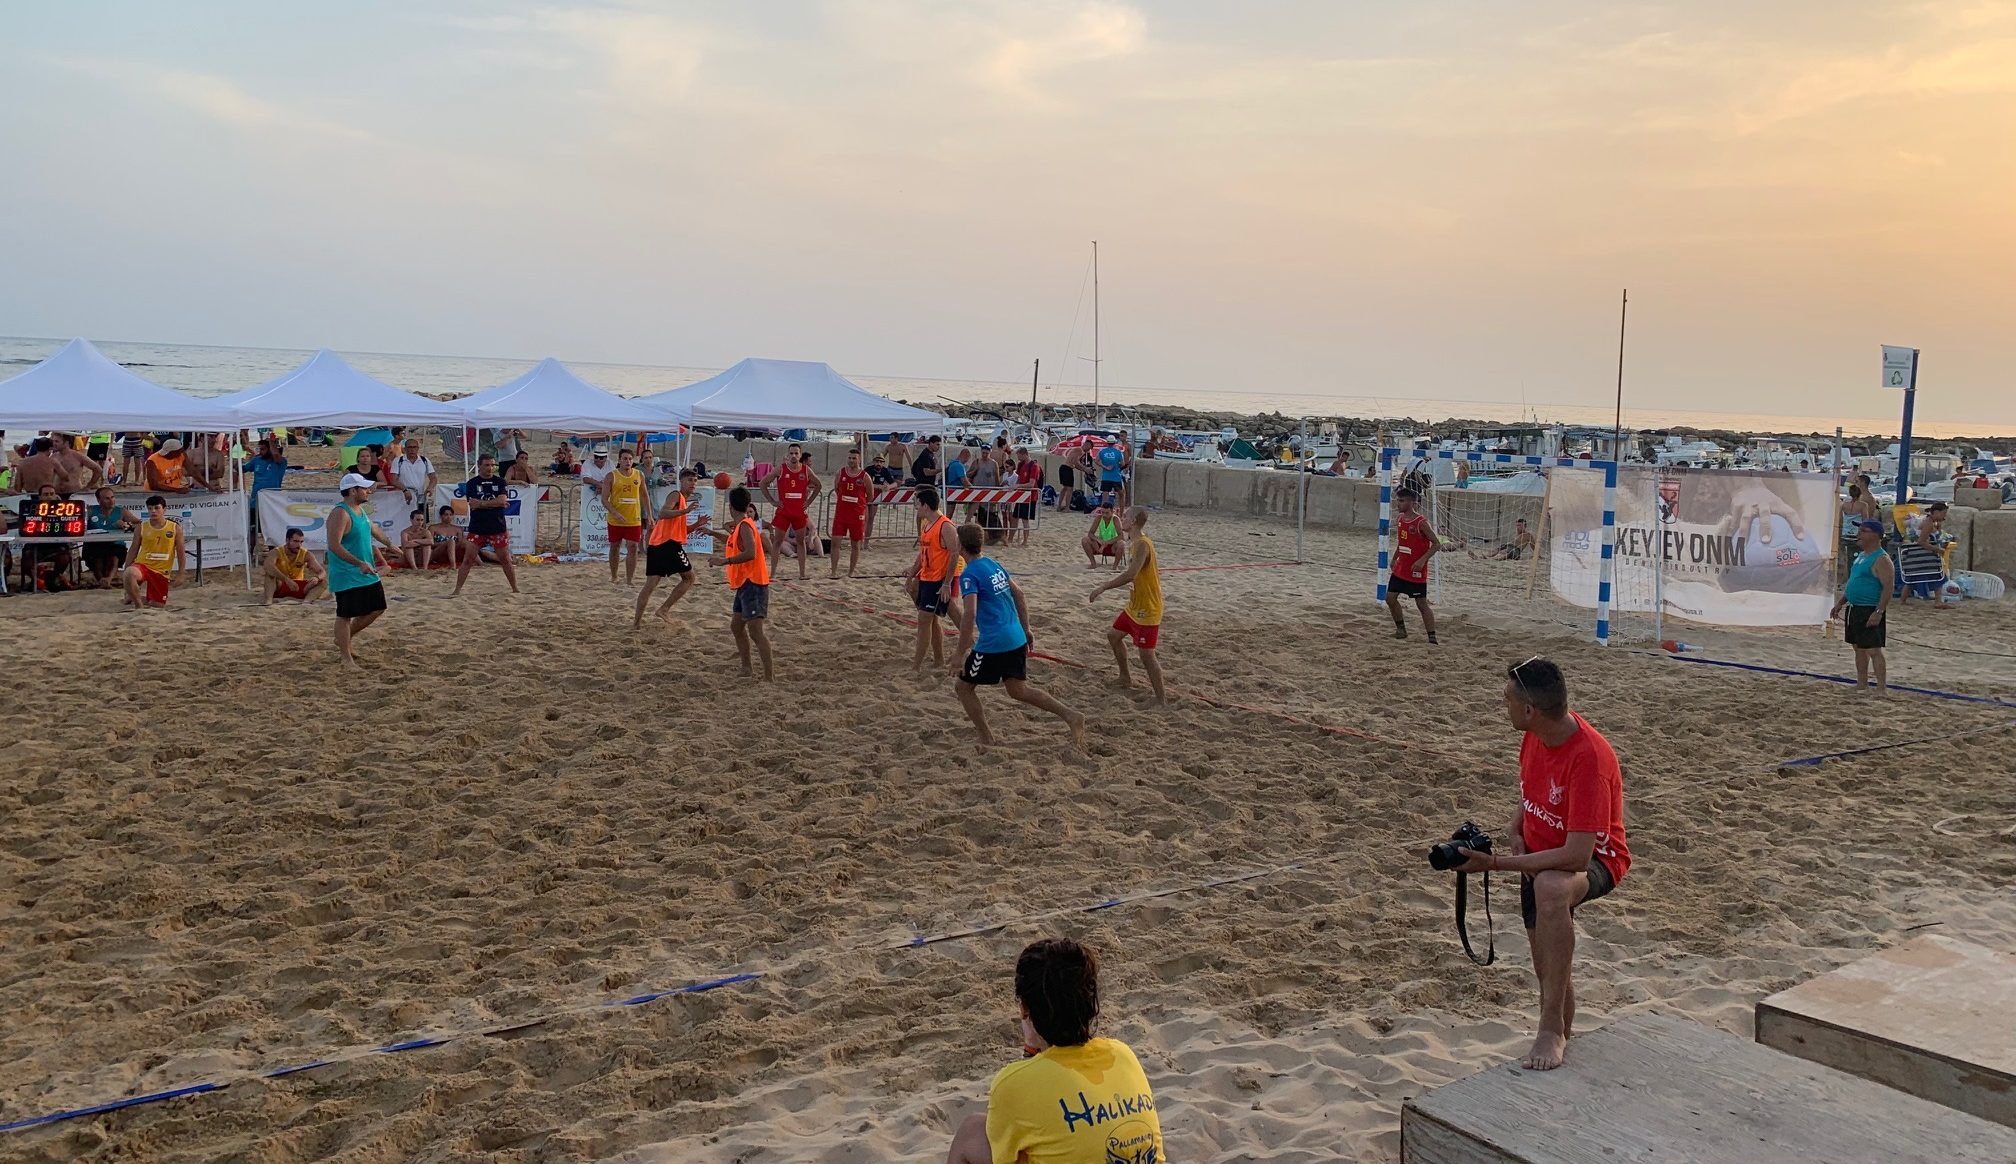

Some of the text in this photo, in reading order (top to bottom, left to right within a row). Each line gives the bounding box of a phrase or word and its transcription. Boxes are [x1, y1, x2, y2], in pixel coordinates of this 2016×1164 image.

[38, 502, 75, 516] 0:20
[199, 500, 238, 509] VIGILANA
[1059, 1091, 1156, 1133] HALIKAD
